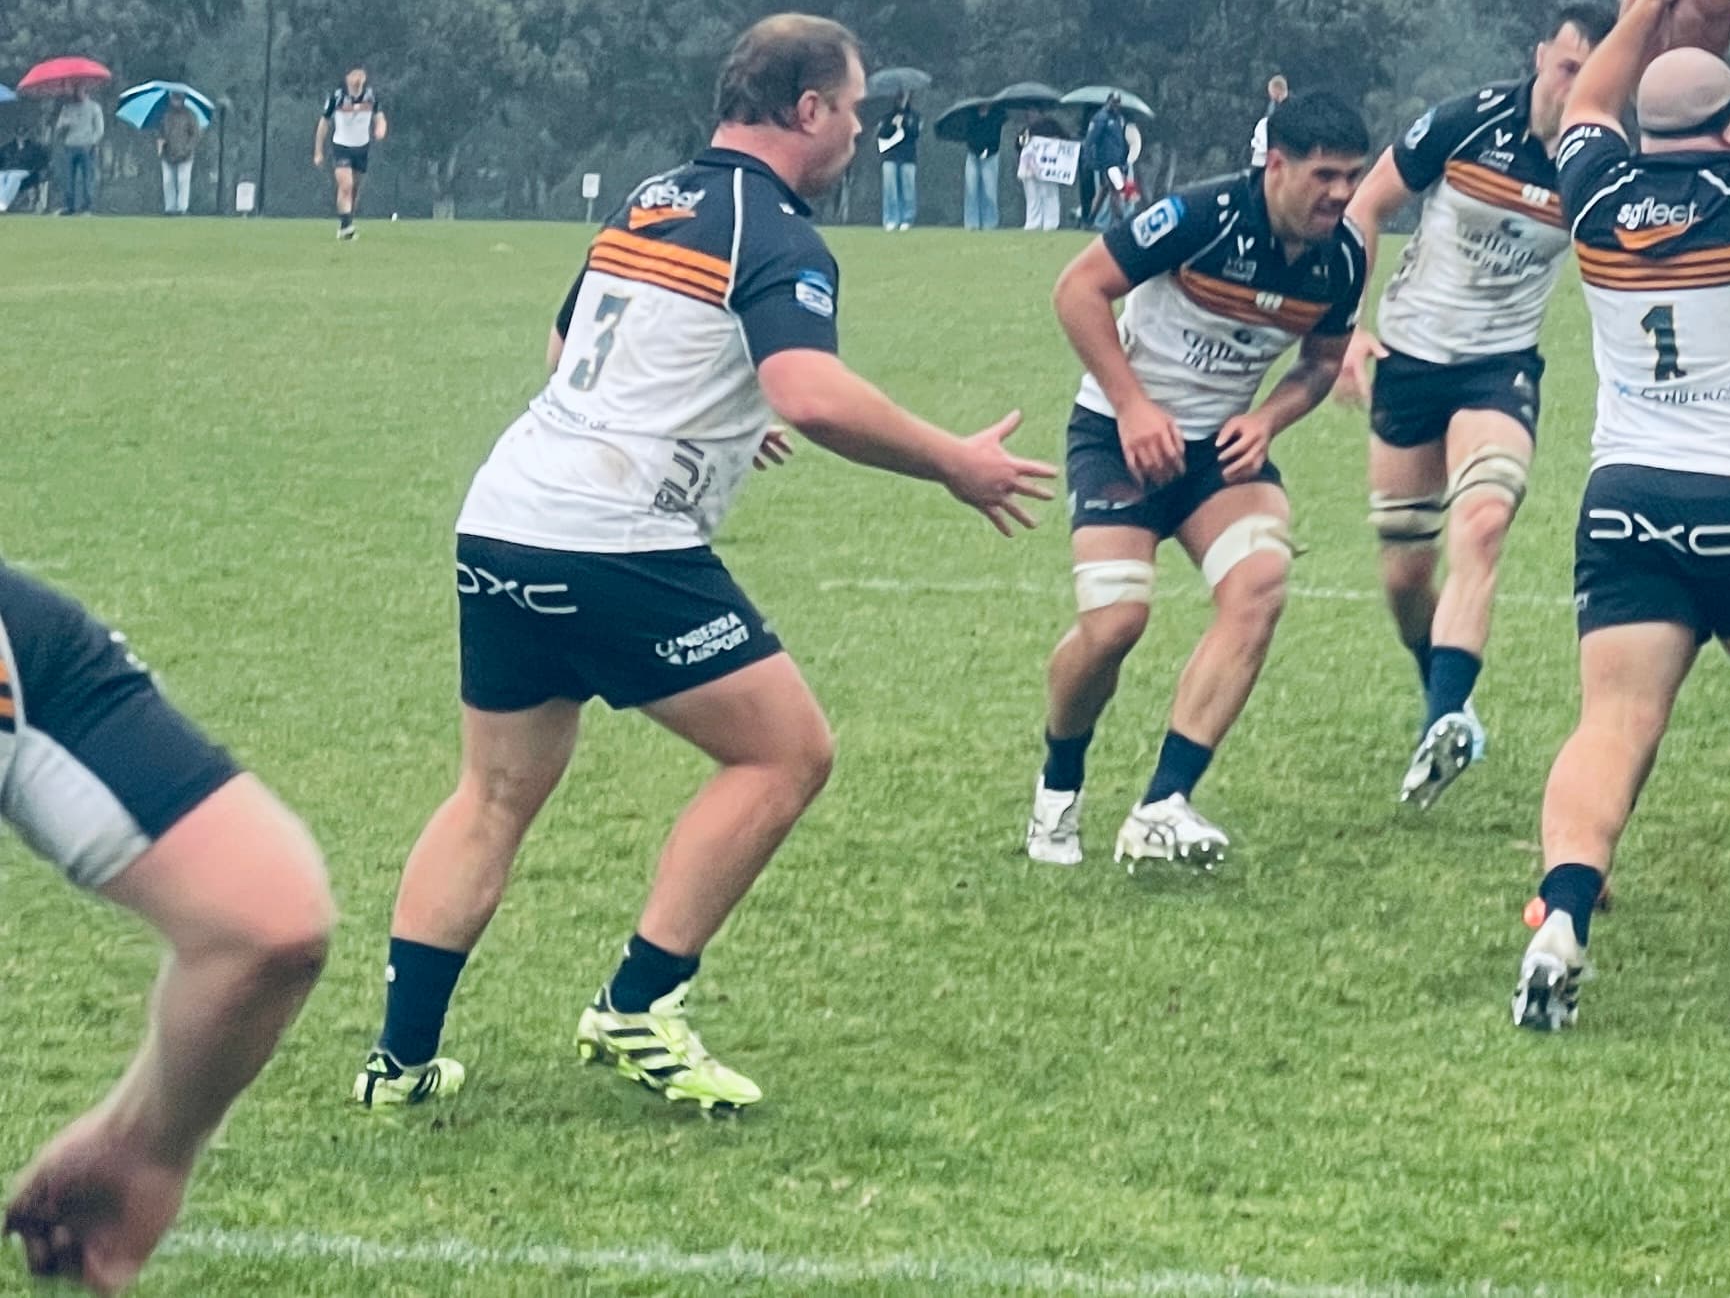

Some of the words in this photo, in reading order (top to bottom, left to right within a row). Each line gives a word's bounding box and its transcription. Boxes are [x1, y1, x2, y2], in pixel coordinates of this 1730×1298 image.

[569, 293, 632, 392] 3
[1640, 304, 1687, 382] 1
[456, 562, 578, 613] DXC
